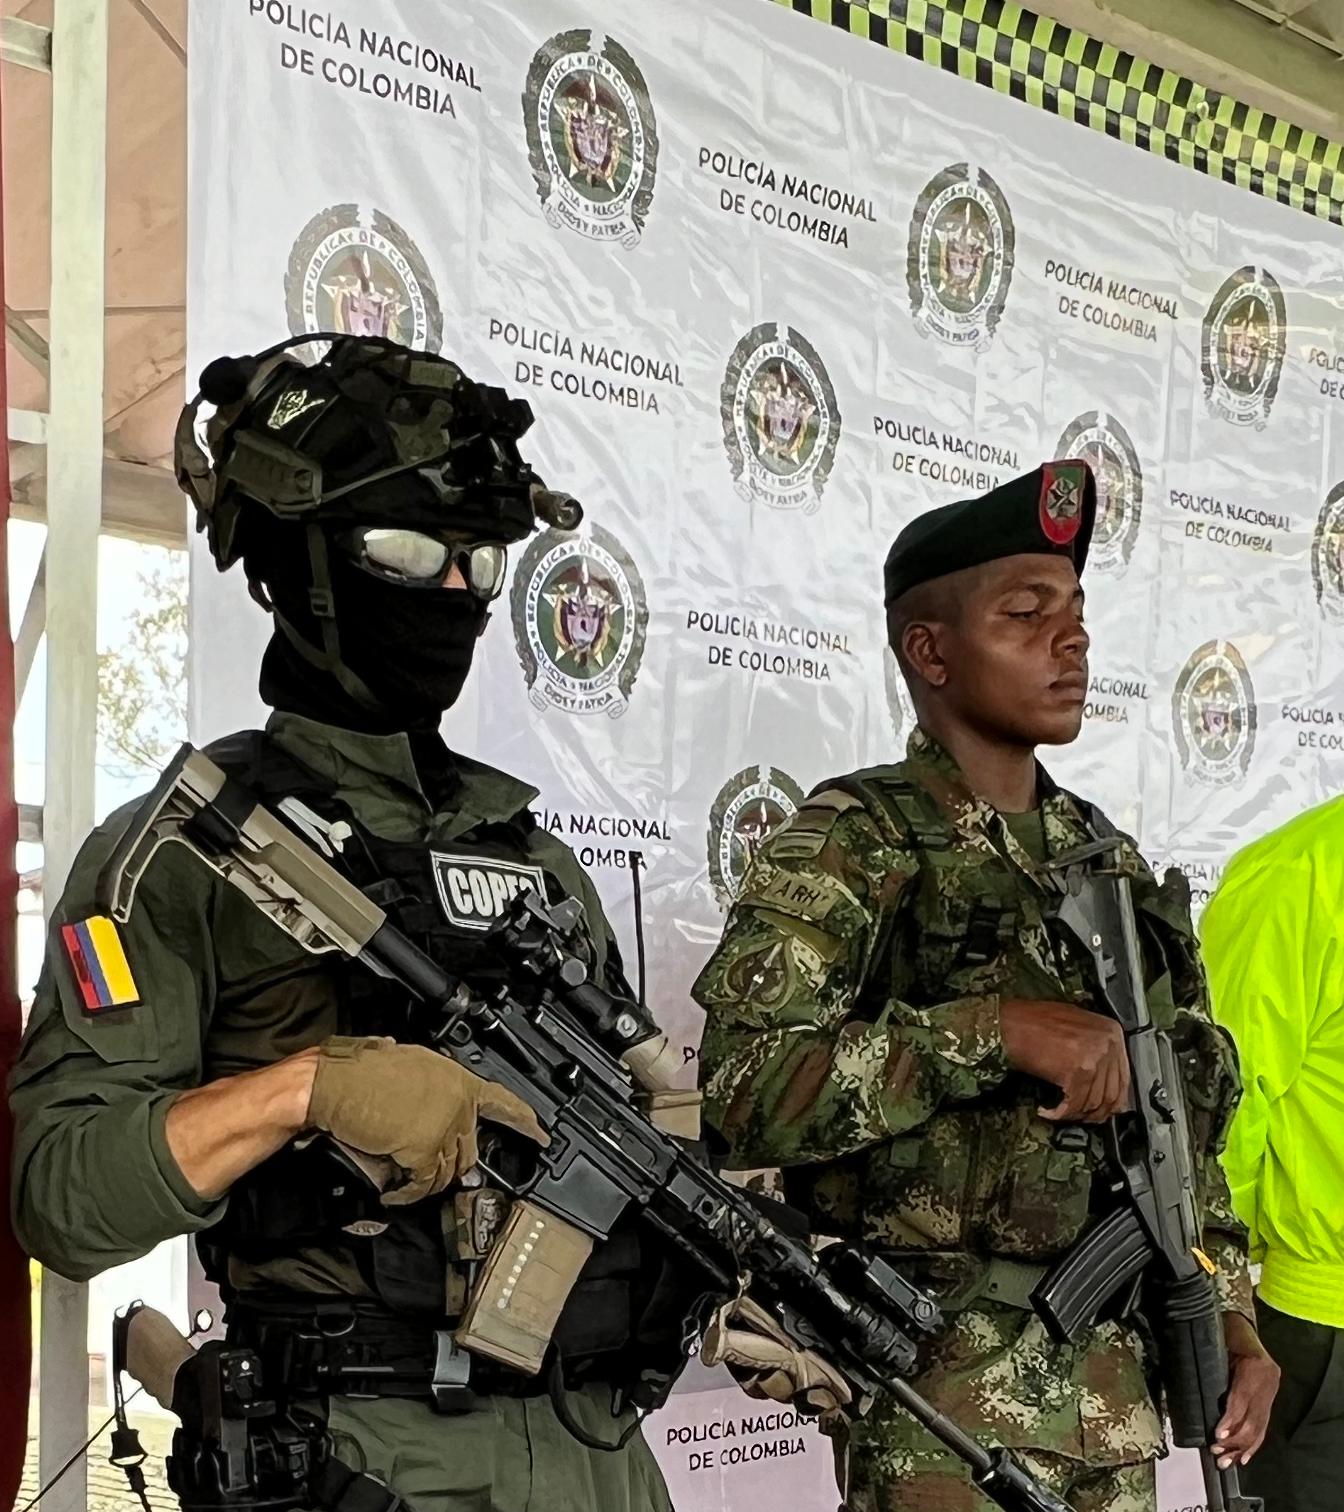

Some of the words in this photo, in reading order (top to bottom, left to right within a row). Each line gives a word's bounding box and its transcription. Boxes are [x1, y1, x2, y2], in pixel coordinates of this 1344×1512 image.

[281, 43, 314, 75] DE
[322, 58, 456, 119] COLOMBIA
[360, 28, 481, 92] NACIONAL
[720, 188, 745, 214] DE
[751, 200, 848, 248] COLOMBIA
[782, 174, 877, 222] NACIONAL
[1059, 296, 1079, 317] DE
[1083, 304, 1157, 342] COLOMBIA
[581, 342, 683, 386] NACIONAL
[516, 361, 543, 385] DE
[551, 369, 659, 415] COLOMBIA
[893, 452, 914, 474] DE
[942, 434, 1020, 471] NACIONAL
[763, 623, 852, 656] NACIONAL
[709, 646, 732, 666] DE
[739, 650, 831, 682] COLOMBIA
[570, 814, 671, 840] NACIONAL
[689, 1451, 714, 1471] DE
[720, 1437, 806, 1466] COLOMBIA
